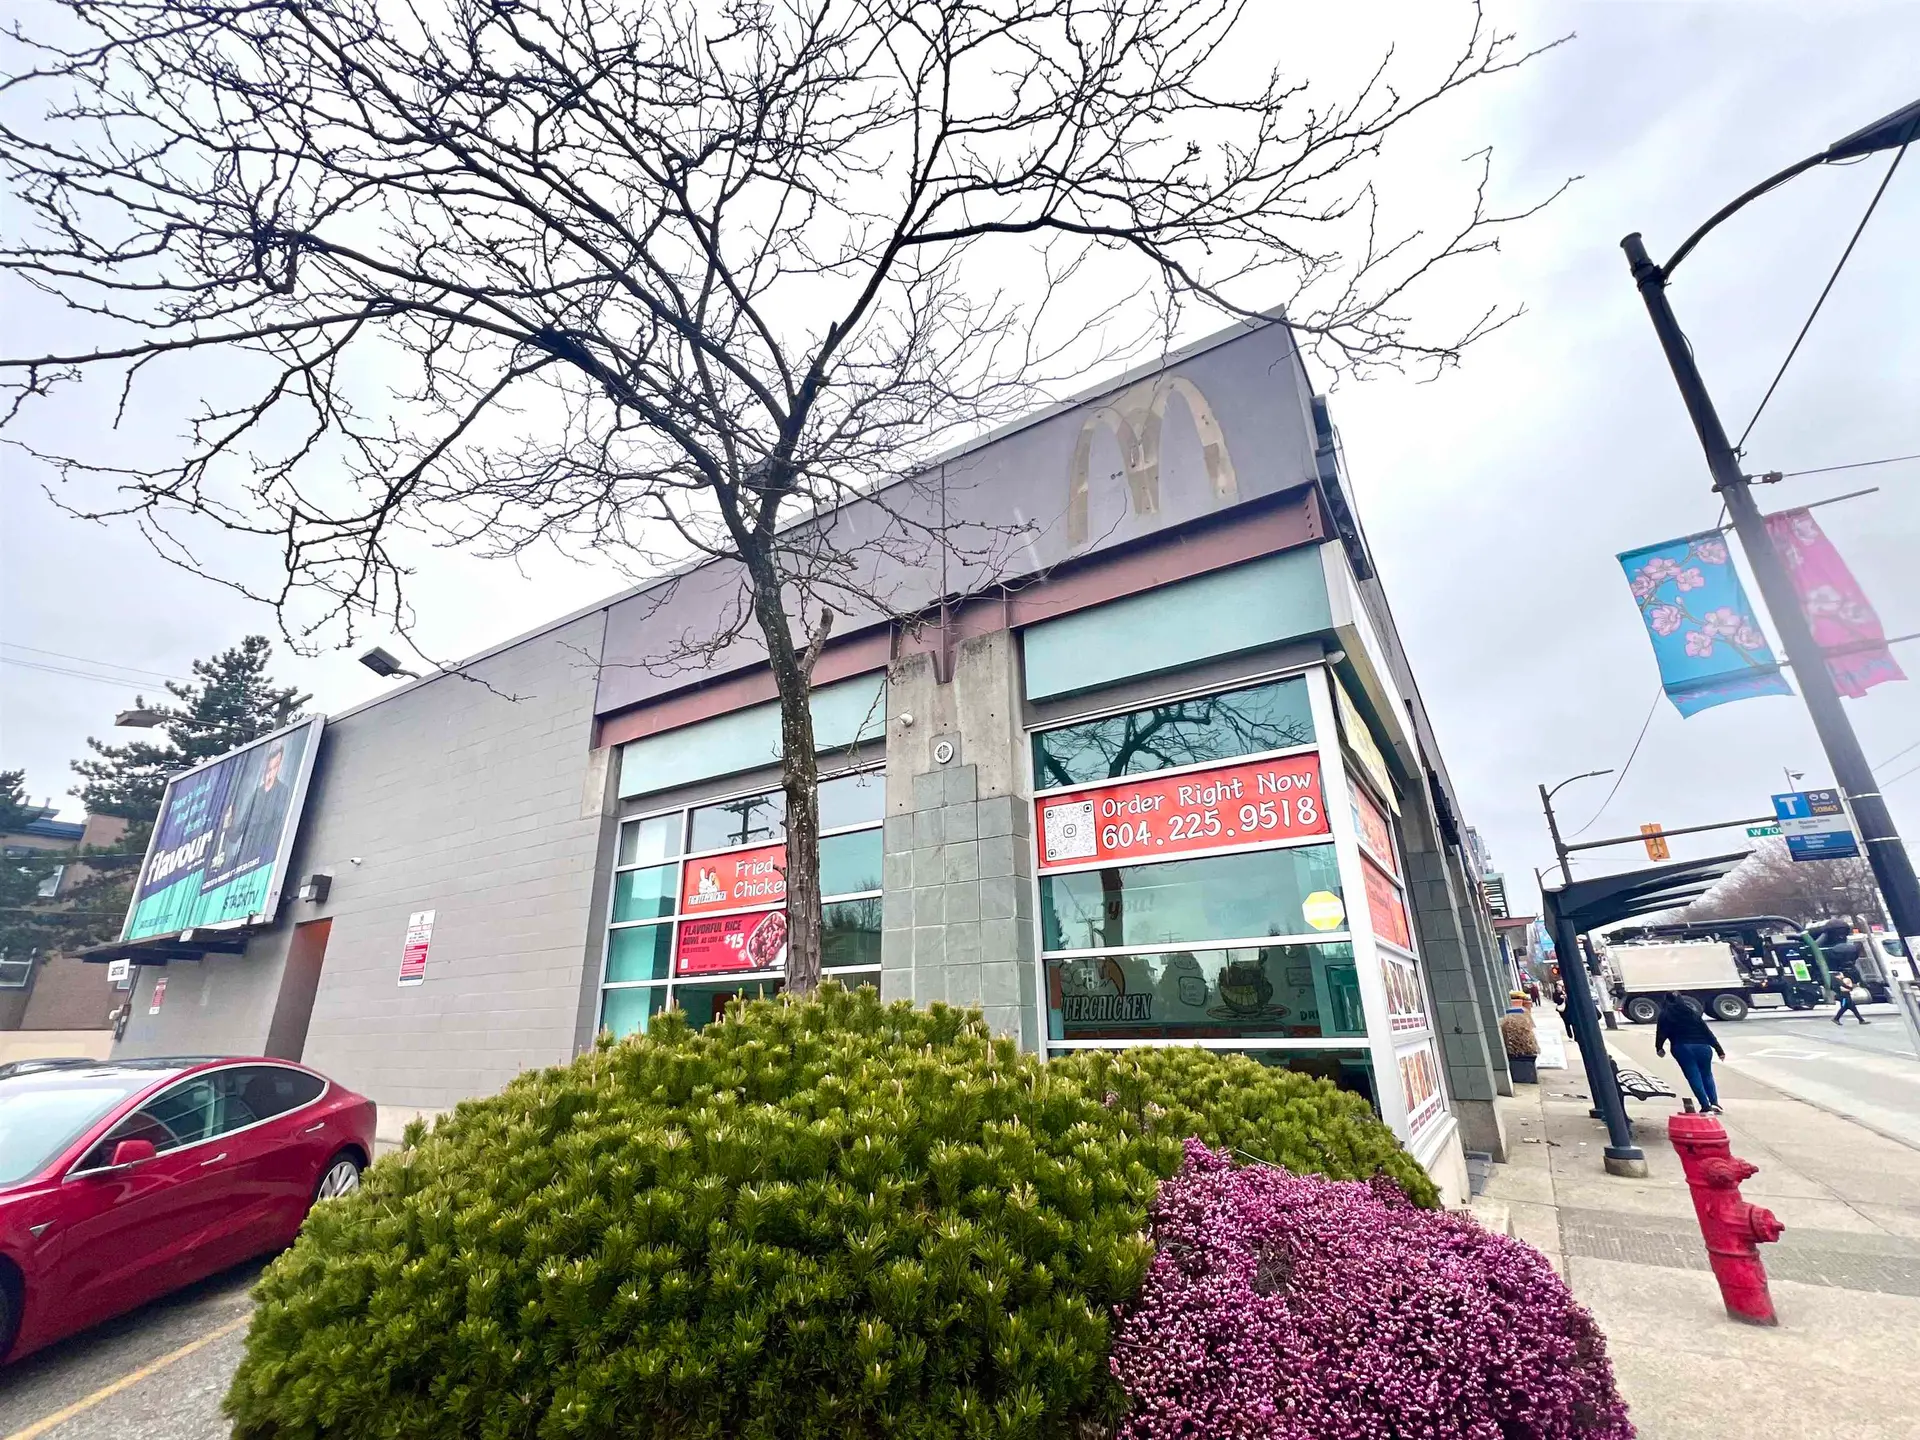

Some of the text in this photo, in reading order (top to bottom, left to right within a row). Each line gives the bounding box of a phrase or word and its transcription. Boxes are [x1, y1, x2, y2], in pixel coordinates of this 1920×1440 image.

[1102, 771, 1312, 818] Order Right Now
[1102, 795, 1318, 850] 604.225.9518
[1750, 828, 1761, 836] W
[145, 829, 213, 886] flavour
[735, 855, 774, 877] Fried
[684, 919, 742, 936] FLAVORFUL RICE
[724, 932, 744, 949] $15
